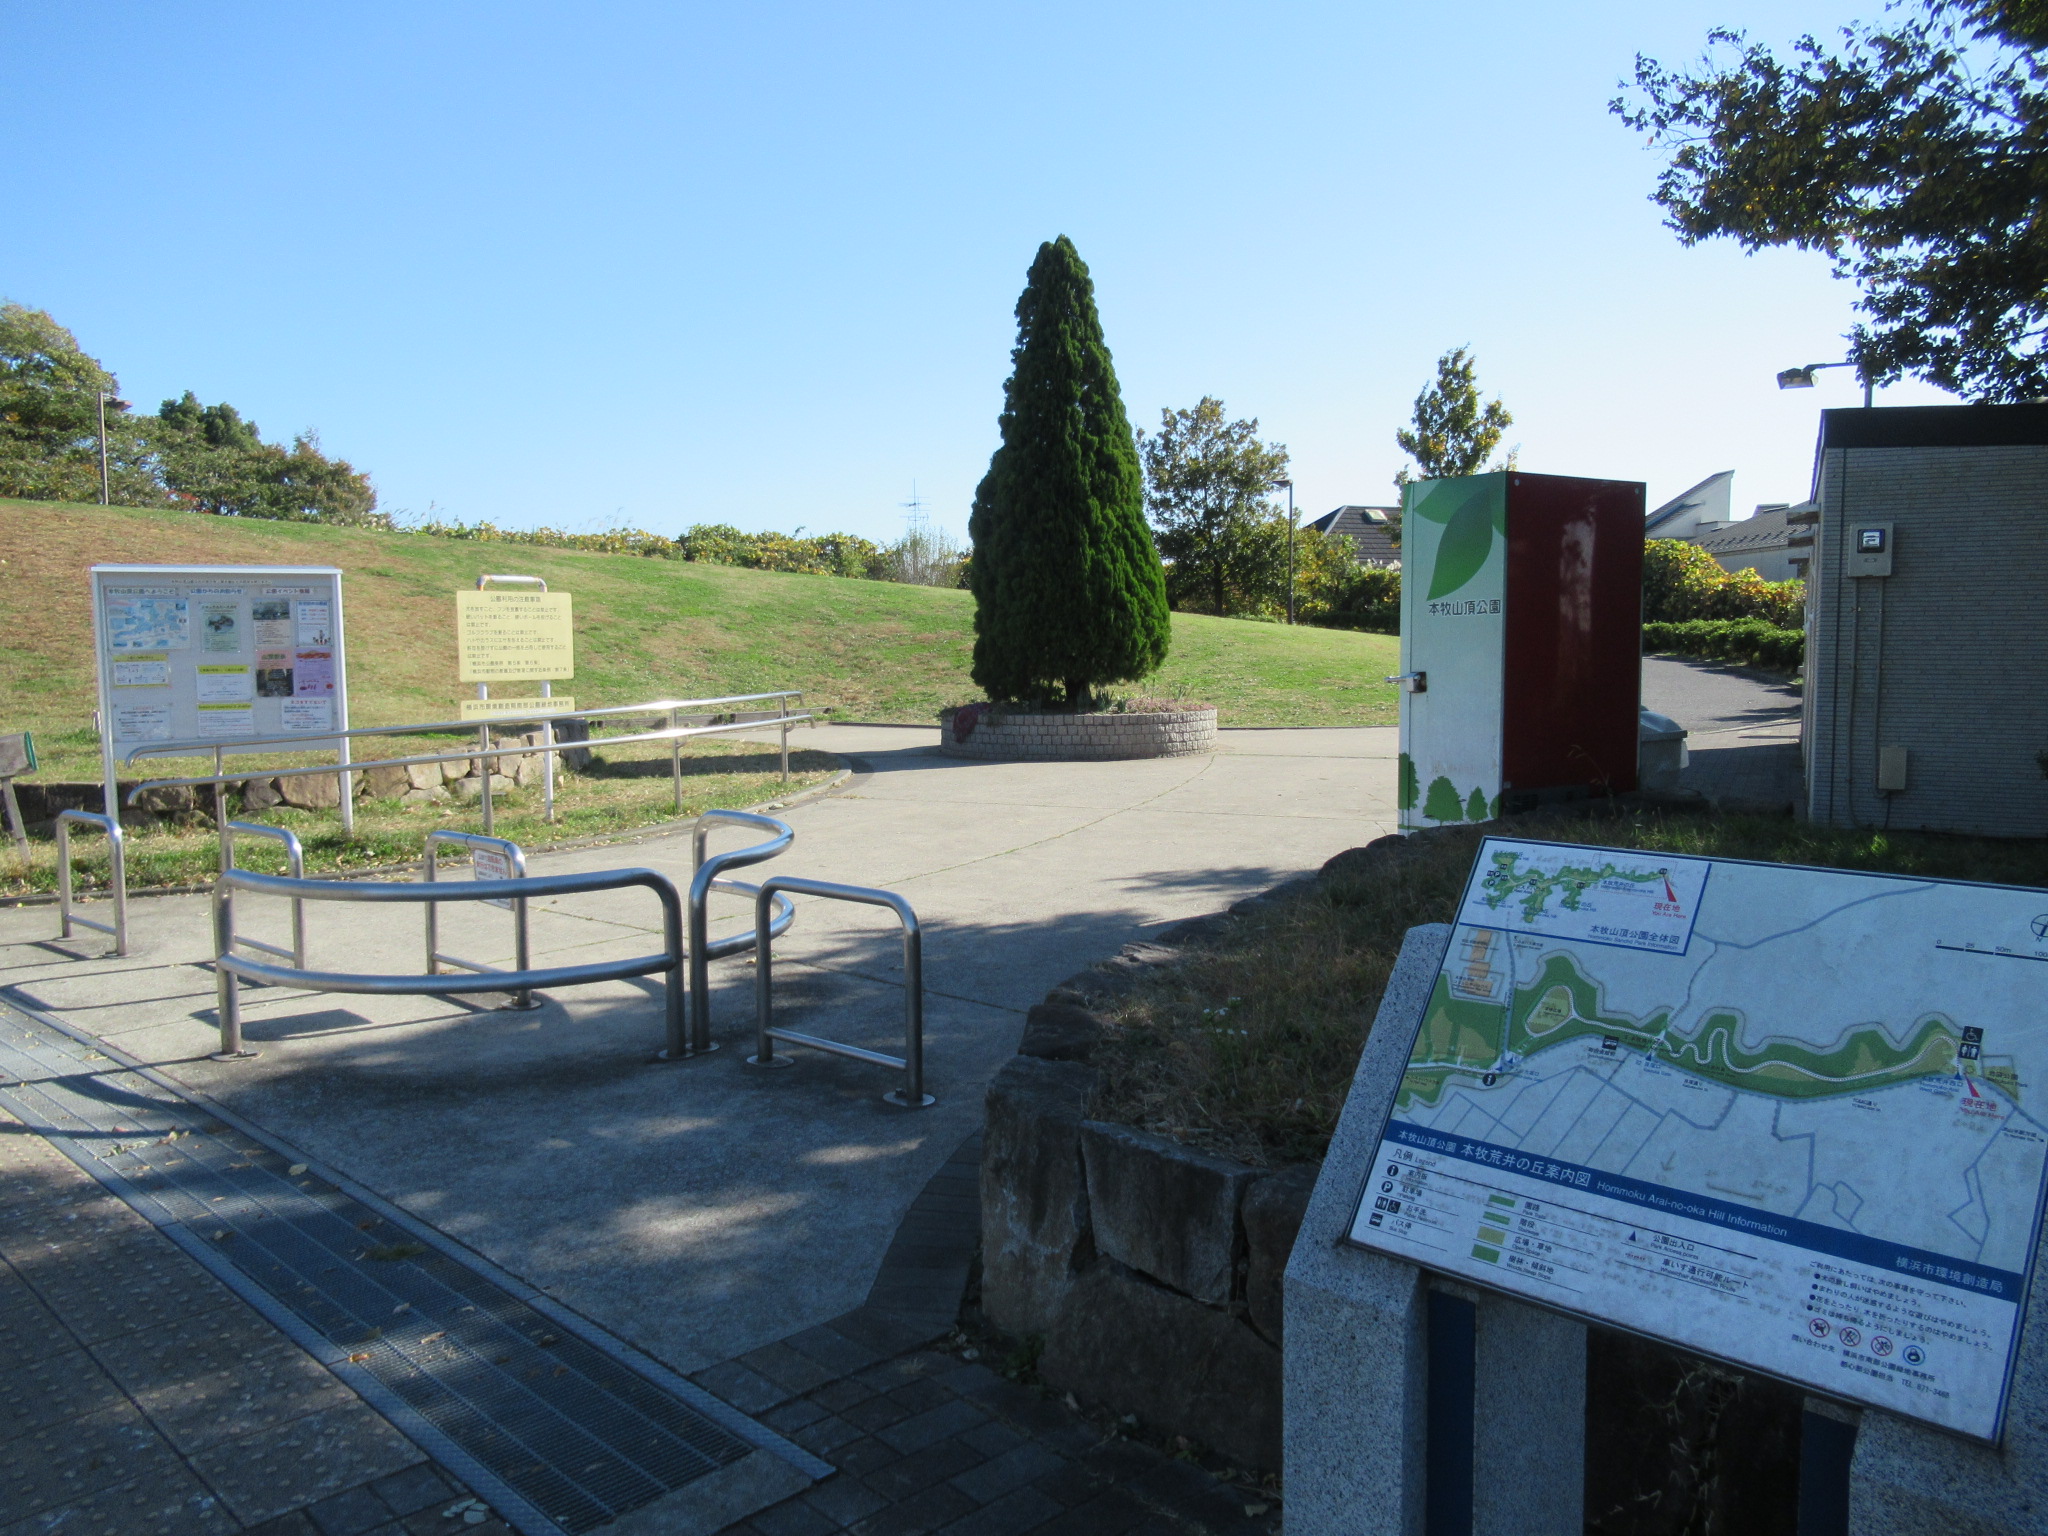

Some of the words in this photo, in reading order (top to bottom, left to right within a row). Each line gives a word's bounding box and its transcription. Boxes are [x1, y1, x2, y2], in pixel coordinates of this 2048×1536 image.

[1428, 599, 1500, 616] 本牧山頂公園
[1653, 902, 1681, 913] 現在地
[1590, 924, 1680, 945] 本牧山頂公園全体図
[1962, 1098, 1997, 1111] 現在地
[1393, 1148, 1413, 1162] 凡例
[1398, 1130, 1456, 1153] 本牧山頂公園
[1460, 1142, 1591, 1187] 本牧荒井の丘案内図
[1415, 1156, 1437, 1167] Legend
[1597, 1180, 1646, 1201] Hommoku
[1648, 1194, 1704, 1216] Arai-no-oka
[1708, 1208, 1725, 1220] Hill
[1728, 1213, 1788, 1237] Information
[1392, 1219, 1412, 1230] バス停
[1520, 1218, 1535, 1228] 階段
[1514, 1236, 1552, 1253] 広場・草地
[1653, 1234, 1694, 1252] 公園出入口
[1662, 1258, 1749, 1289] 車いす通行可能ルート
[1896, 1256, 2003, 1293] 横浜市環境創造局
[1791, 1333, 1835, 1352] 問い合わせ先
[1901, 1378, 1914, 1388] TEL
